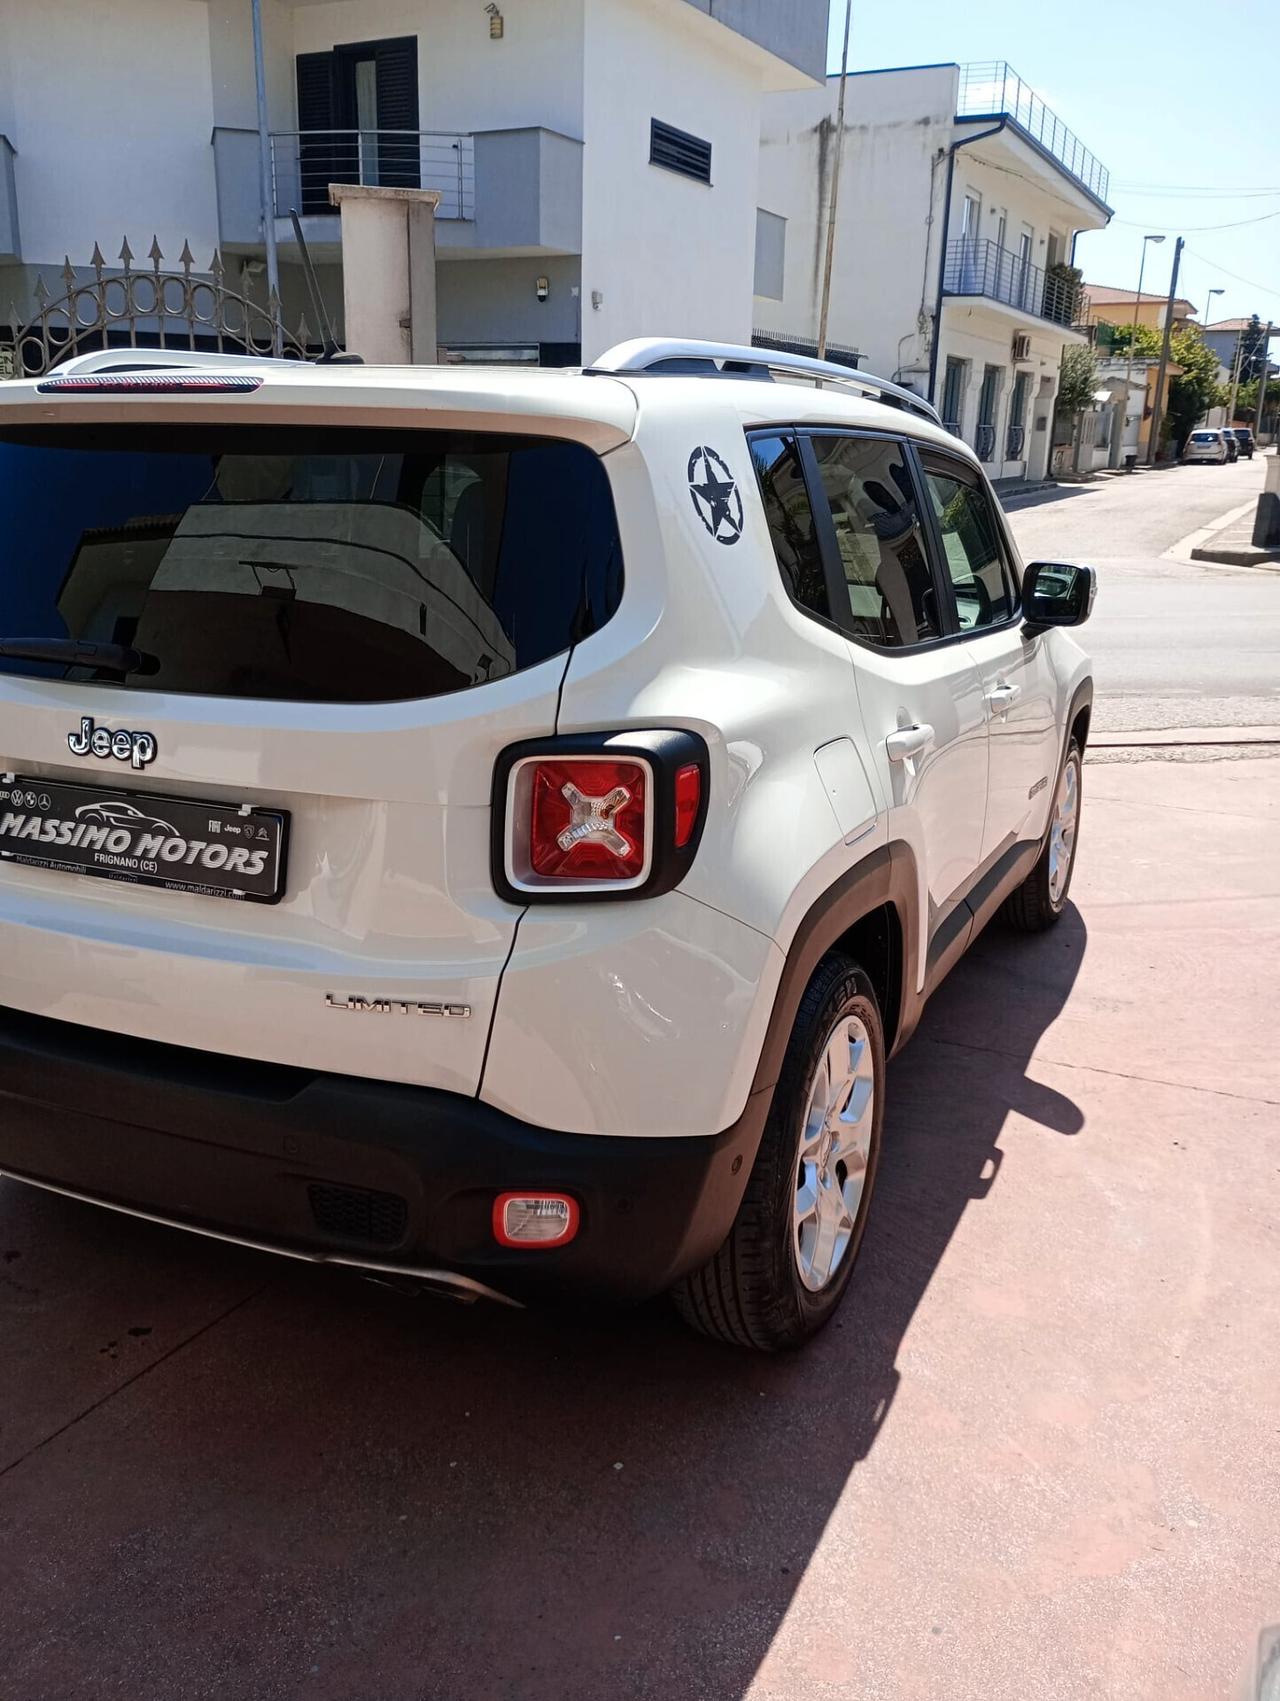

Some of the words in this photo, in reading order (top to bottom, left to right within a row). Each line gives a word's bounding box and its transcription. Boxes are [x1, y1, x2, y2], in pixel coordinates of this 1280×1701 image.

[68, 716, 158, 770] Jeep
[224, 824, 241, 834] Jeep
[0, 812, 131, 853] MASSIMO
[136, 834, 268, 876] MOTORS
[94, 852, 139, 869] FRIGNANO
[140, 859, 158, 874] (CE)
[325, 993, 472, 1019] LIMITED
